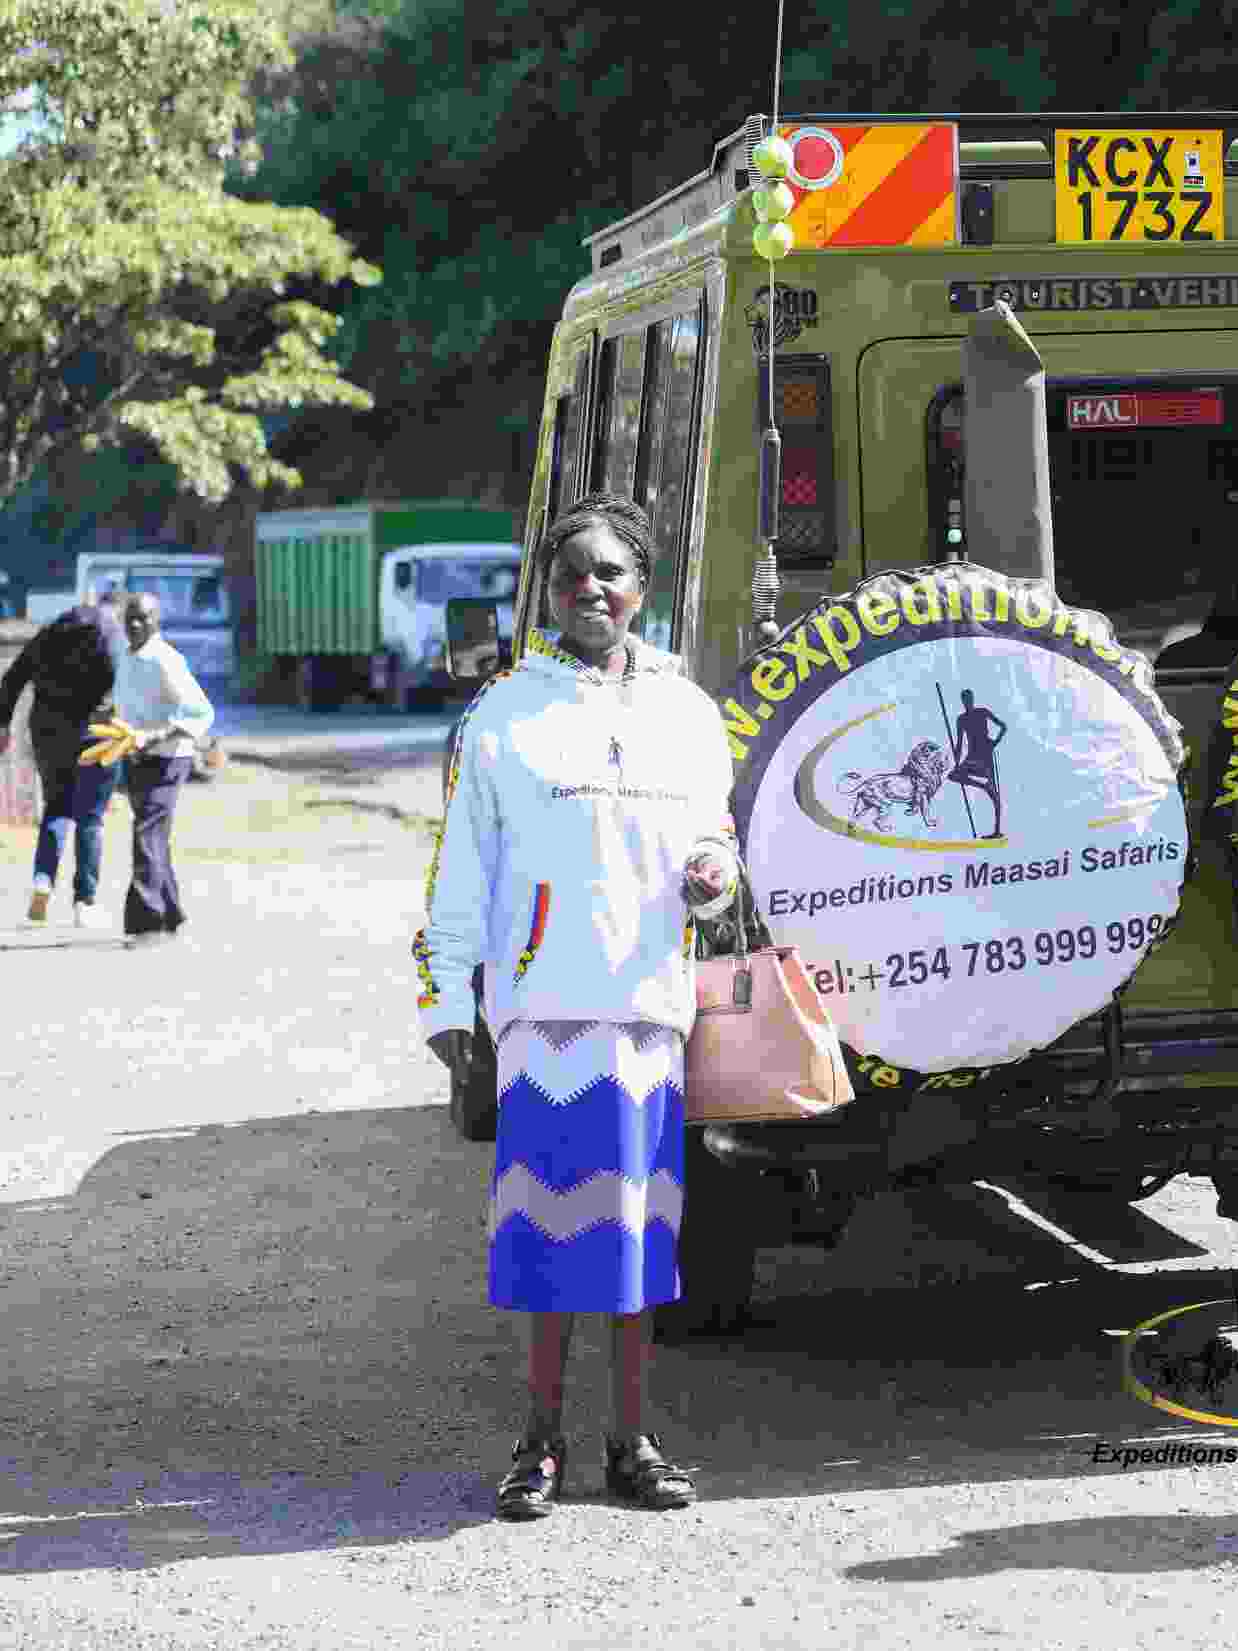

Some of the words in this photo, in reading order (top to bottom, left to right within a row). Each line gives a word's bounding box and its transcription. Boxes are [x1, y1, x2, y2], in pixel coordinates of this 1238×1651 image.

[1067, 136, 1175, 187] KCX
[1076, 191, 1213, 240] 173Z
[768, 870, 953, 916] Expeditions
[964, 850, 1070, 889] Maasai
[1080, 837, 1183, 873] Safaris
[961, 936, 1026, 976] 783
[1034, 926, 1097, 966] 999
